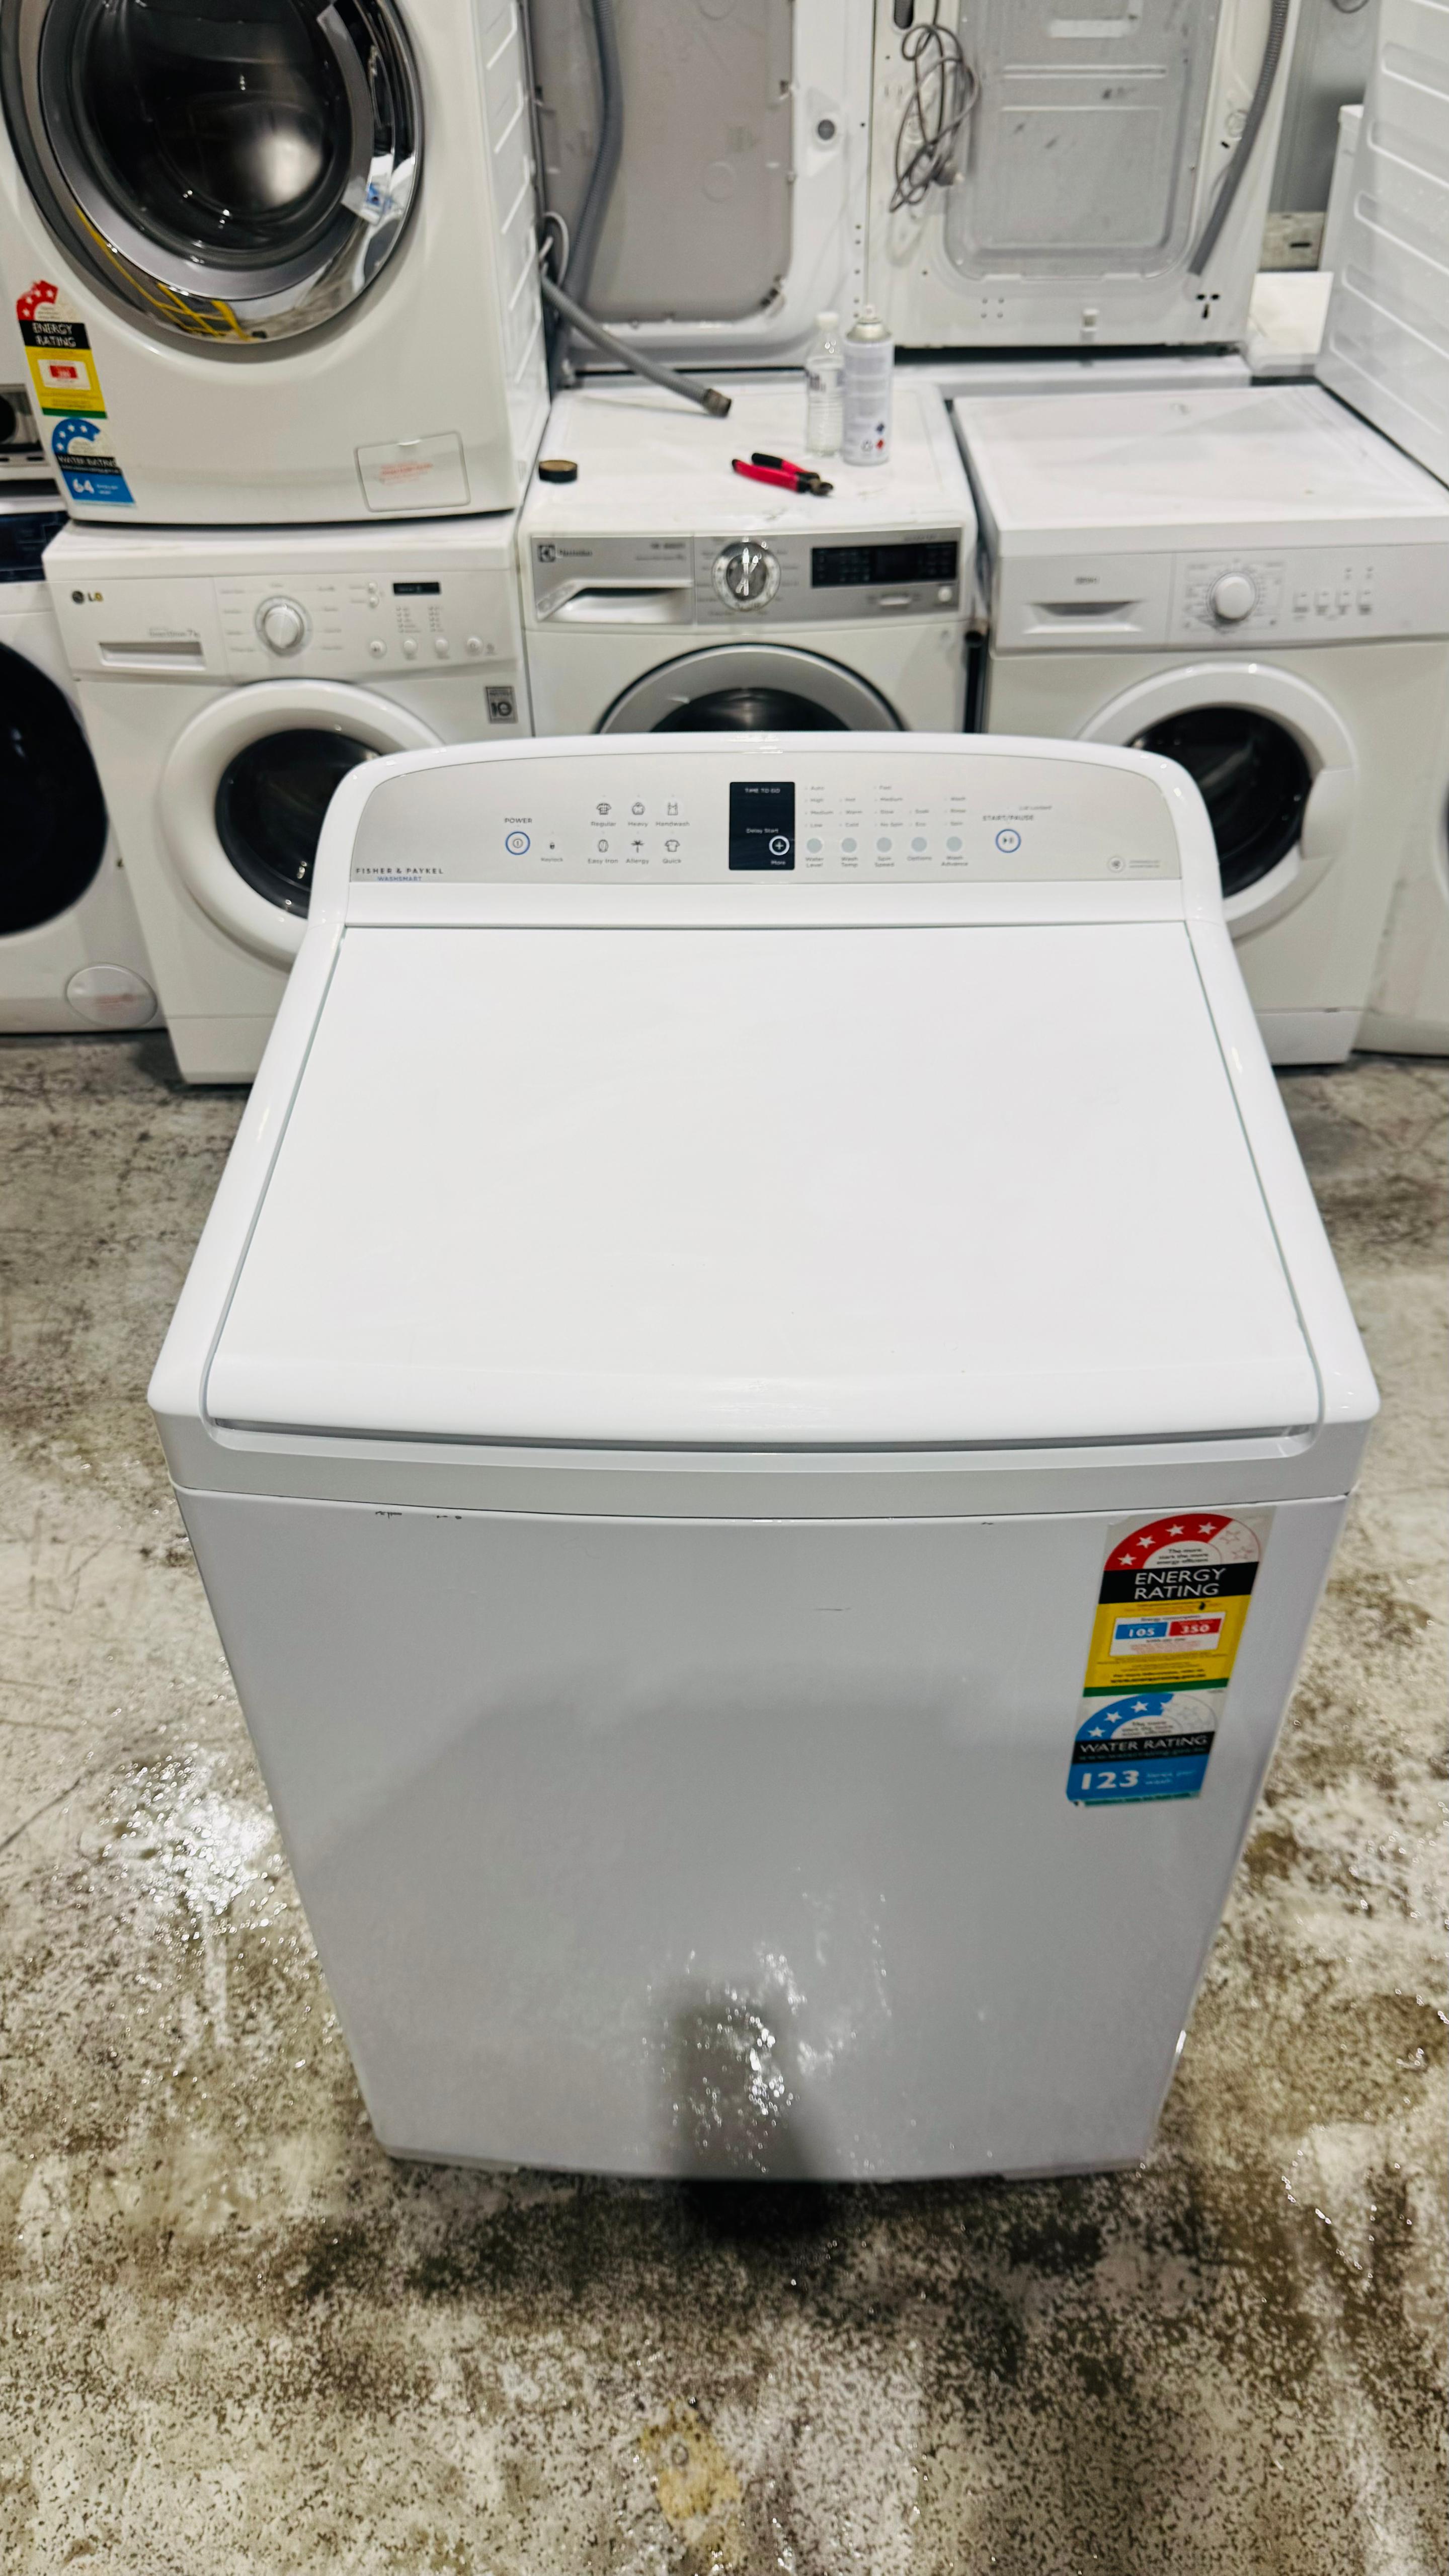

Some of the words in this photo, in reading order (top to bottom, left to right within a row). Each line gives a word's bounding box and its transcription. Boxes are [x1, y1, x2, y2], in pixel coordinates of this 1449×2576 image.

[33, 323, 72, 335] ENERGY
[35, 335, 76, 347] RATING
[72, 478, 95, 494] 64
[88, 592, 104, 602] LG
[1135, 1568, 1227, 1585] ENERGY
[1134, 1583, 1220, 1600] RATING
[1129, 1628, 1155, 1638] 105
[1080, 1741, 1138, 1753] WATER
[1144, 1735, 1208, 1750] RATING
[1081, 1770, 1140, 1790] 123
